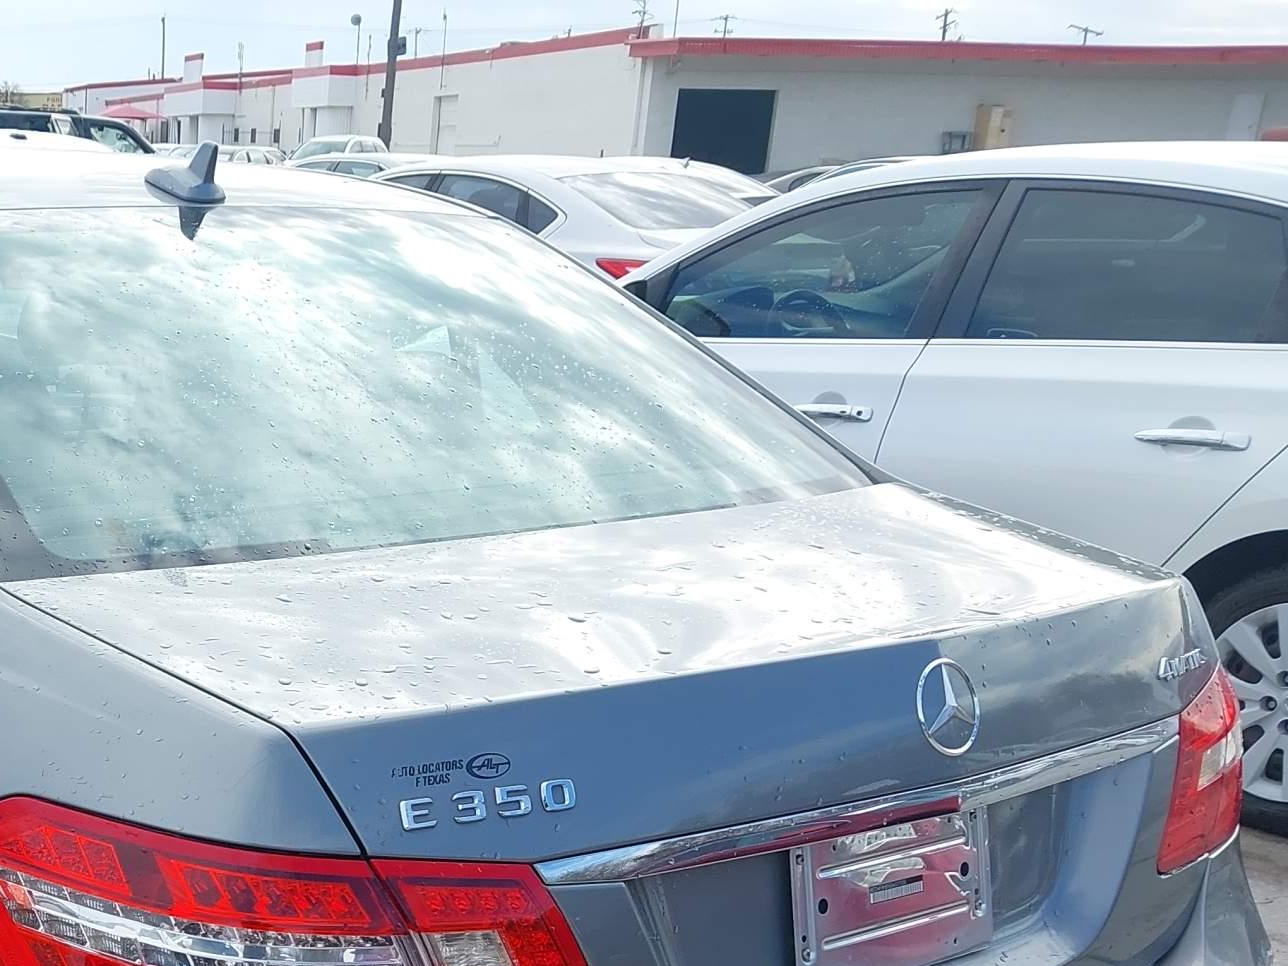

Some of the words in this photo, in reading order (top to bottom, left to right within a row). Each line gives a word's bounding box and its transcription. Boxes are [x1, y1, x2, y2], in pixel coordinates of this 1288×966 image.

[417, 759, 464, 775] LOCATORS
[422, 773, 451, 787] TEXAS
[399, 797, 438, 832] E
[451, 778, 577, 824] 350
